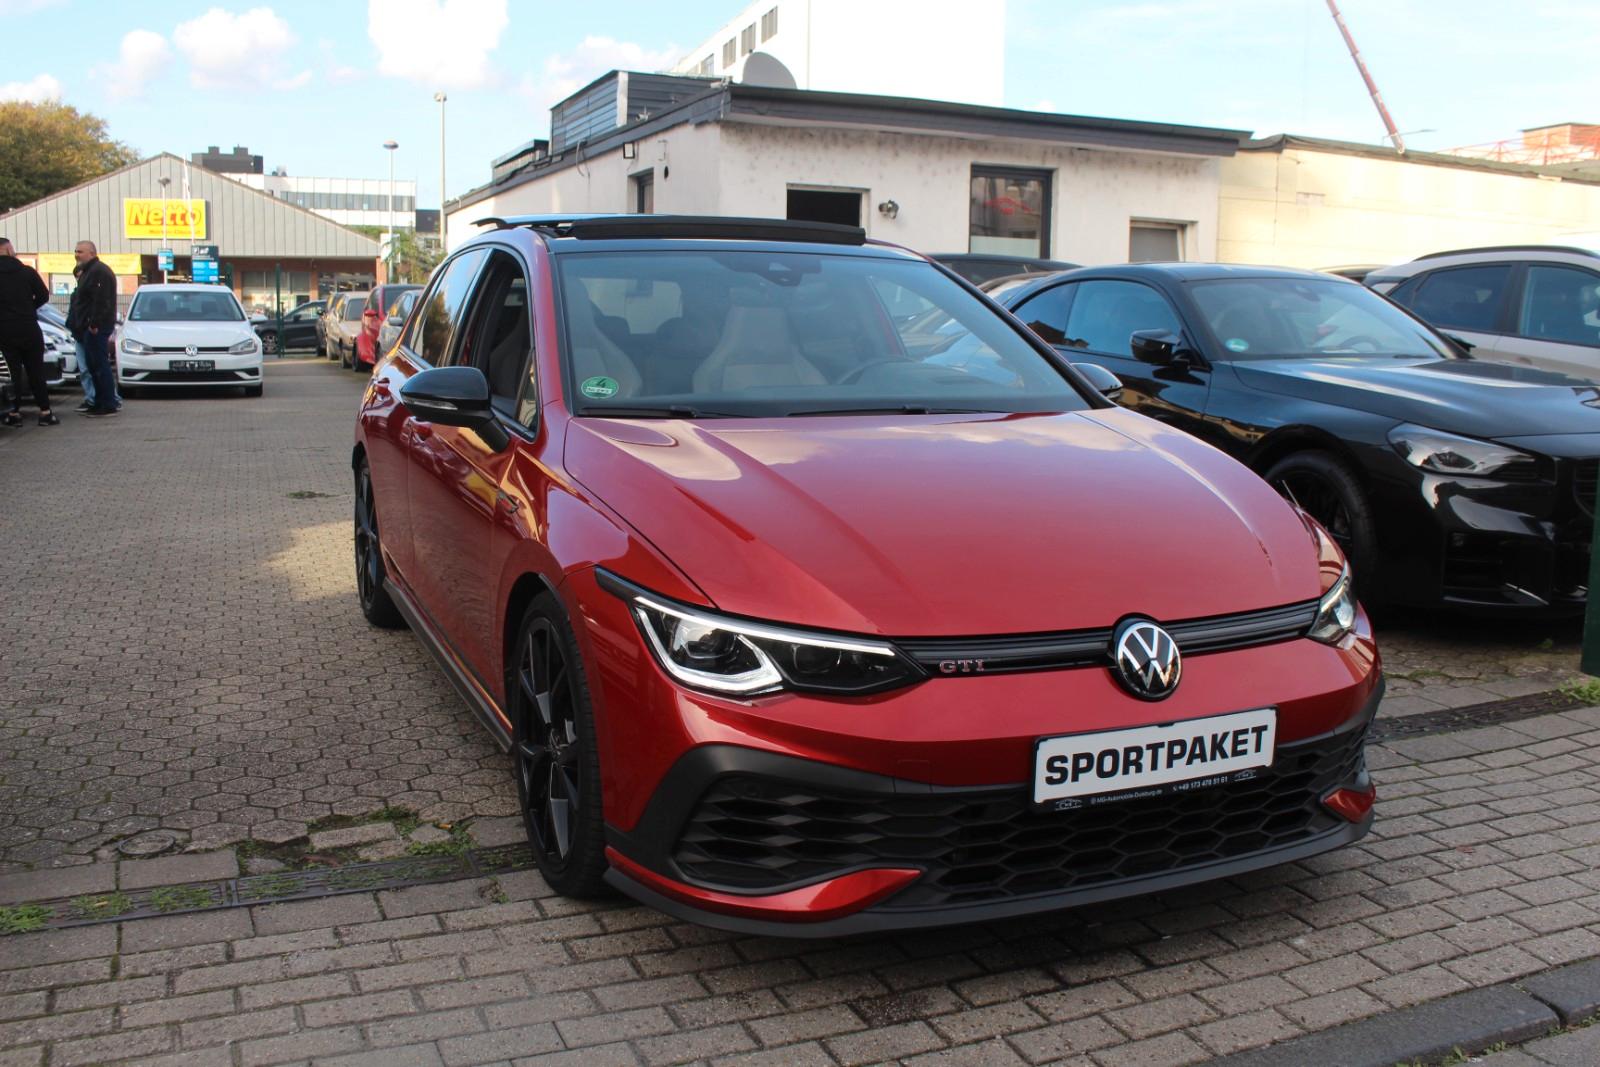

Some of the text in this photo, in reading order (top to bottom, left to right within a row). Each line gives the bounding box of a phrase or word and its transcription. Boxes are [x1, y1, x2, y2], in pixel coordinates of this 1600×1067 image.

[128, 203, 202, 226] Netto
[595, 377, 607, 389] 4
[939, 658, 985, 674] GTI
[1045, 724, 1268, 786] SPORTPAKET
